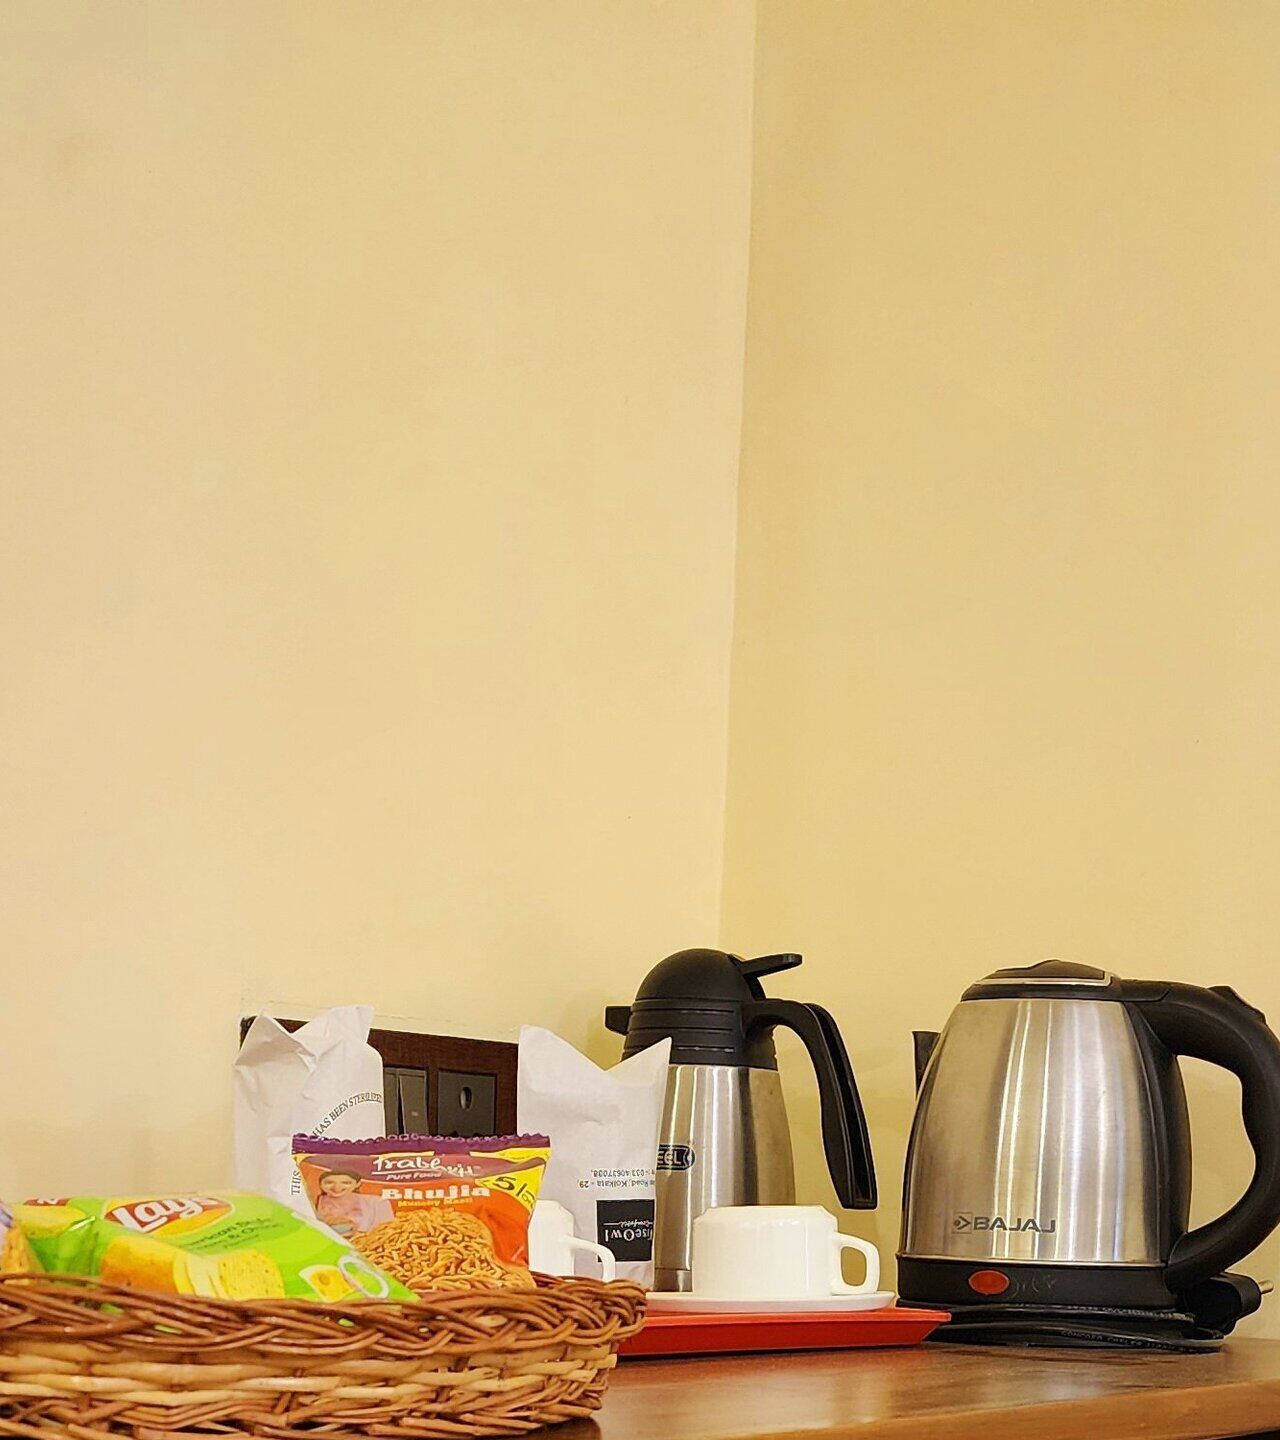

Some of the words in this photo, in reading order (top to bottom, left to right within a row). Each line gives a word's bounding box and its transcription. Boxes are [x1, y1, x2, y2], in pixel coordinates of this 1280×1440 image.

[329, 1100, 349, 1121] BEEN
[381, 1184, 491, 1201] Bhujia
[973, 1216, 1056, 1233] BAJAJ
